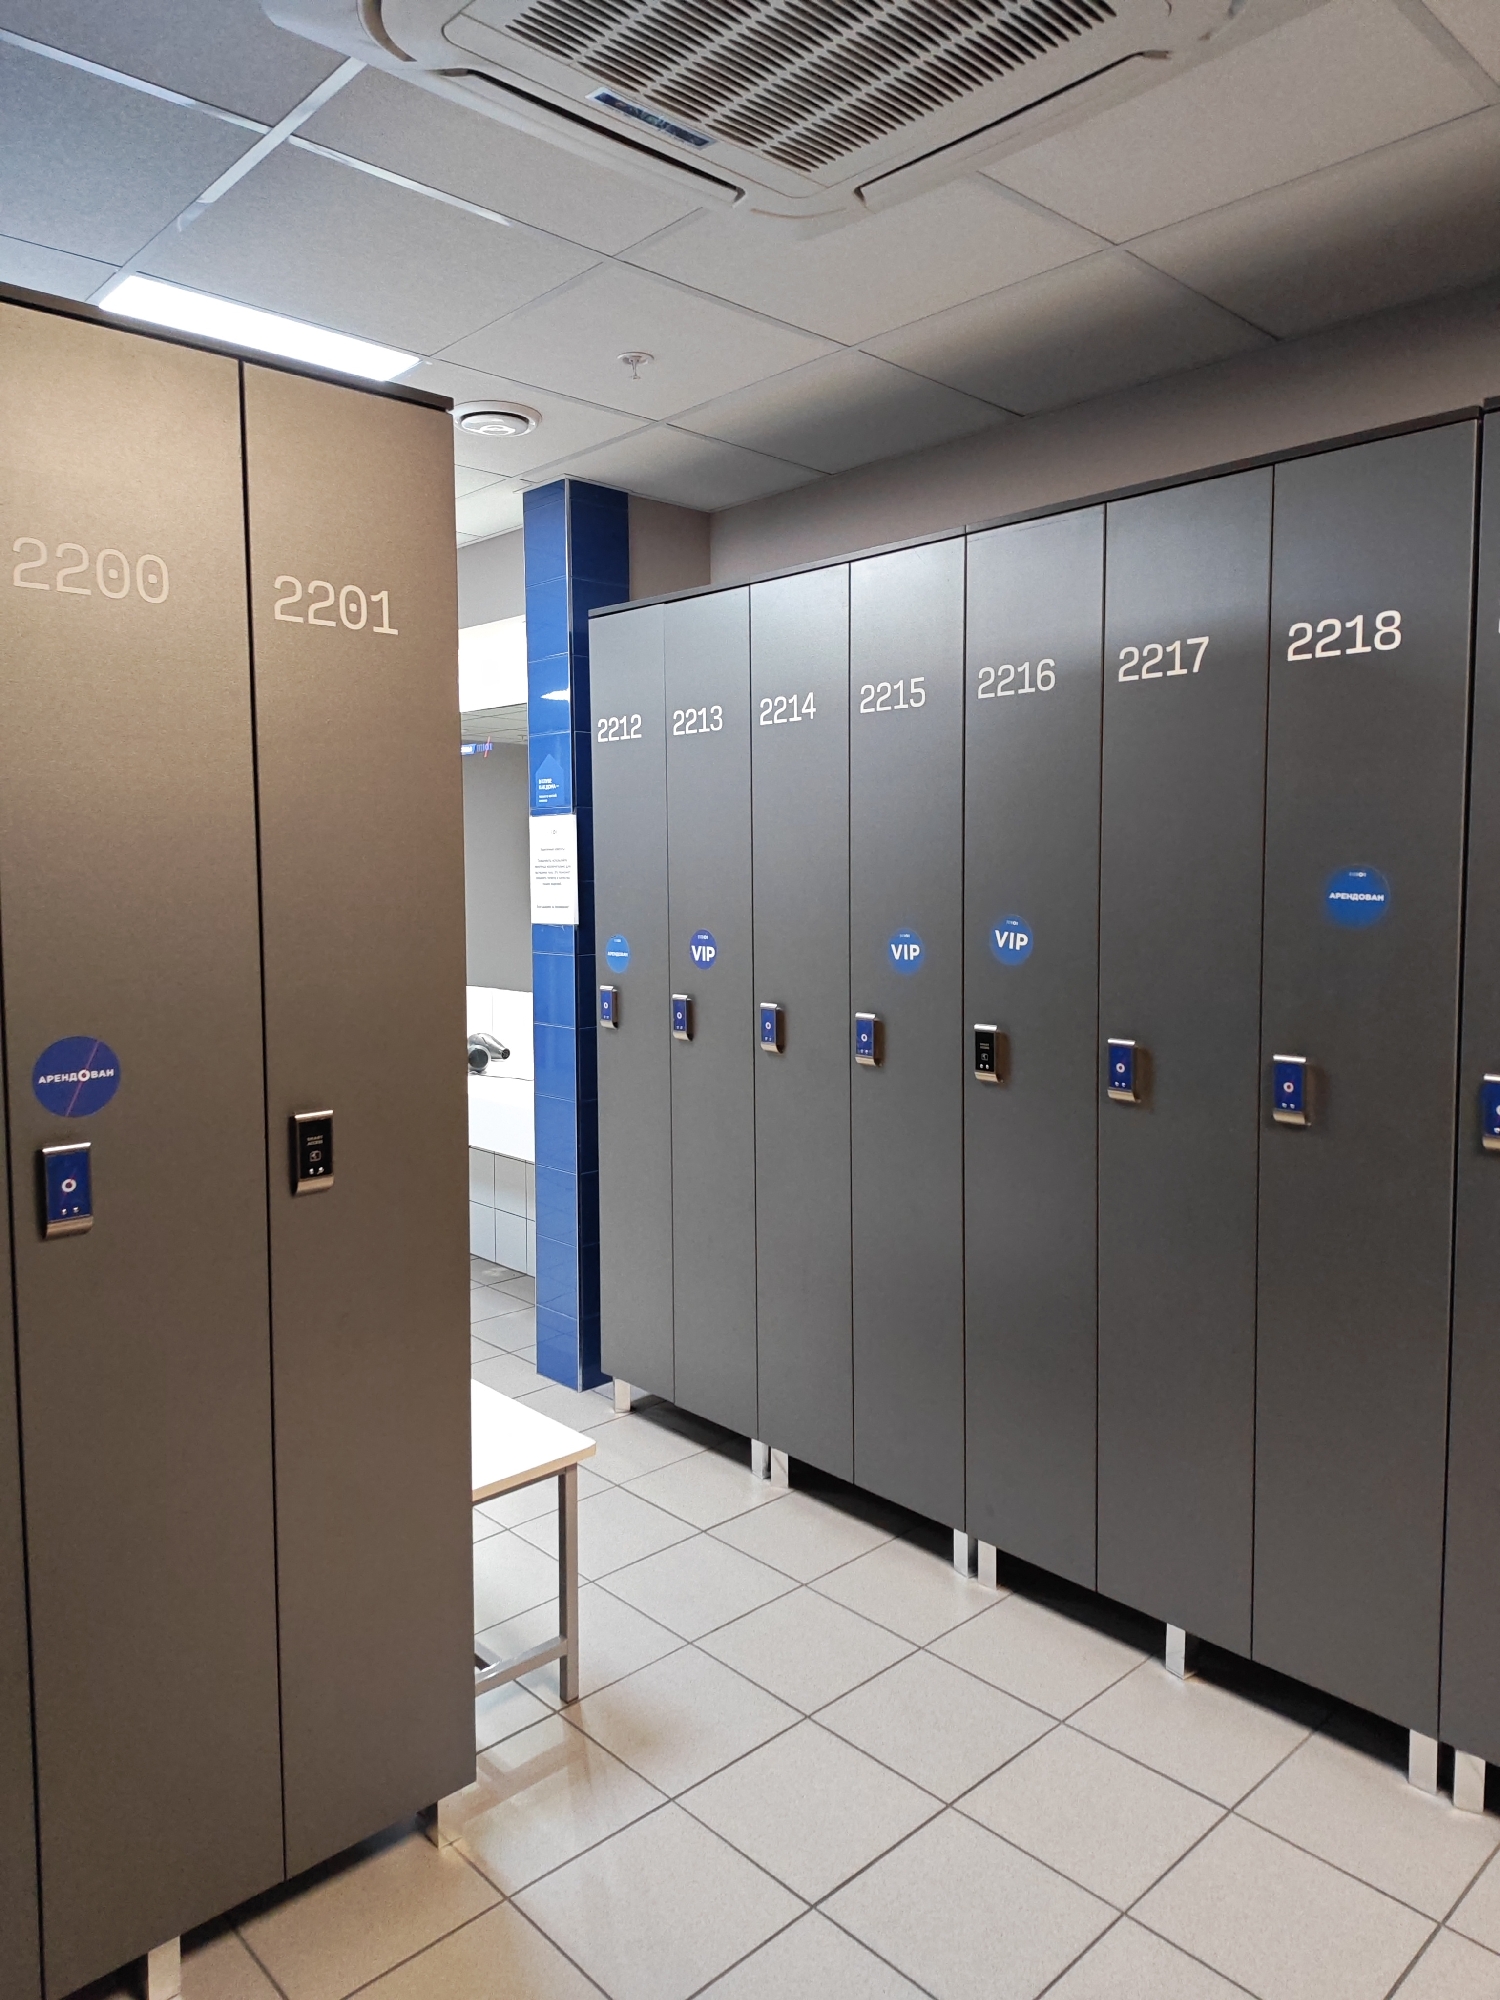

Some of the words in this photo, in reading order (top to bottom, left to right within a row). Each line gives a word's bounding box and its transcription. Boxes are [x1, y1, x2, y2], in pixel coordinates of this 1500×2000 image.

[12, 537, 170, 604] 2200
[274, 575, 399, 636] 2201
[1287, 611, 1402, 662] 2218
[1118, 636, 1209, 683] 2217
[978, 658, 1056, 699] 2216
[759, 691, 817, 726] 2214
[859, 676, 926, 714] 2215
[597, 713, 642, 743] 2212
[672, 706, 723, 736] 2213
[1329, 892, 1385, 902] АРЕНДОВАН
[691, 945, 716, 962] VIP
[891, 944, 920, 960] VIP
[995, 930, 1029, 951] VIP
[38, 1068, 115, 1085] АРЕНДОВАН
